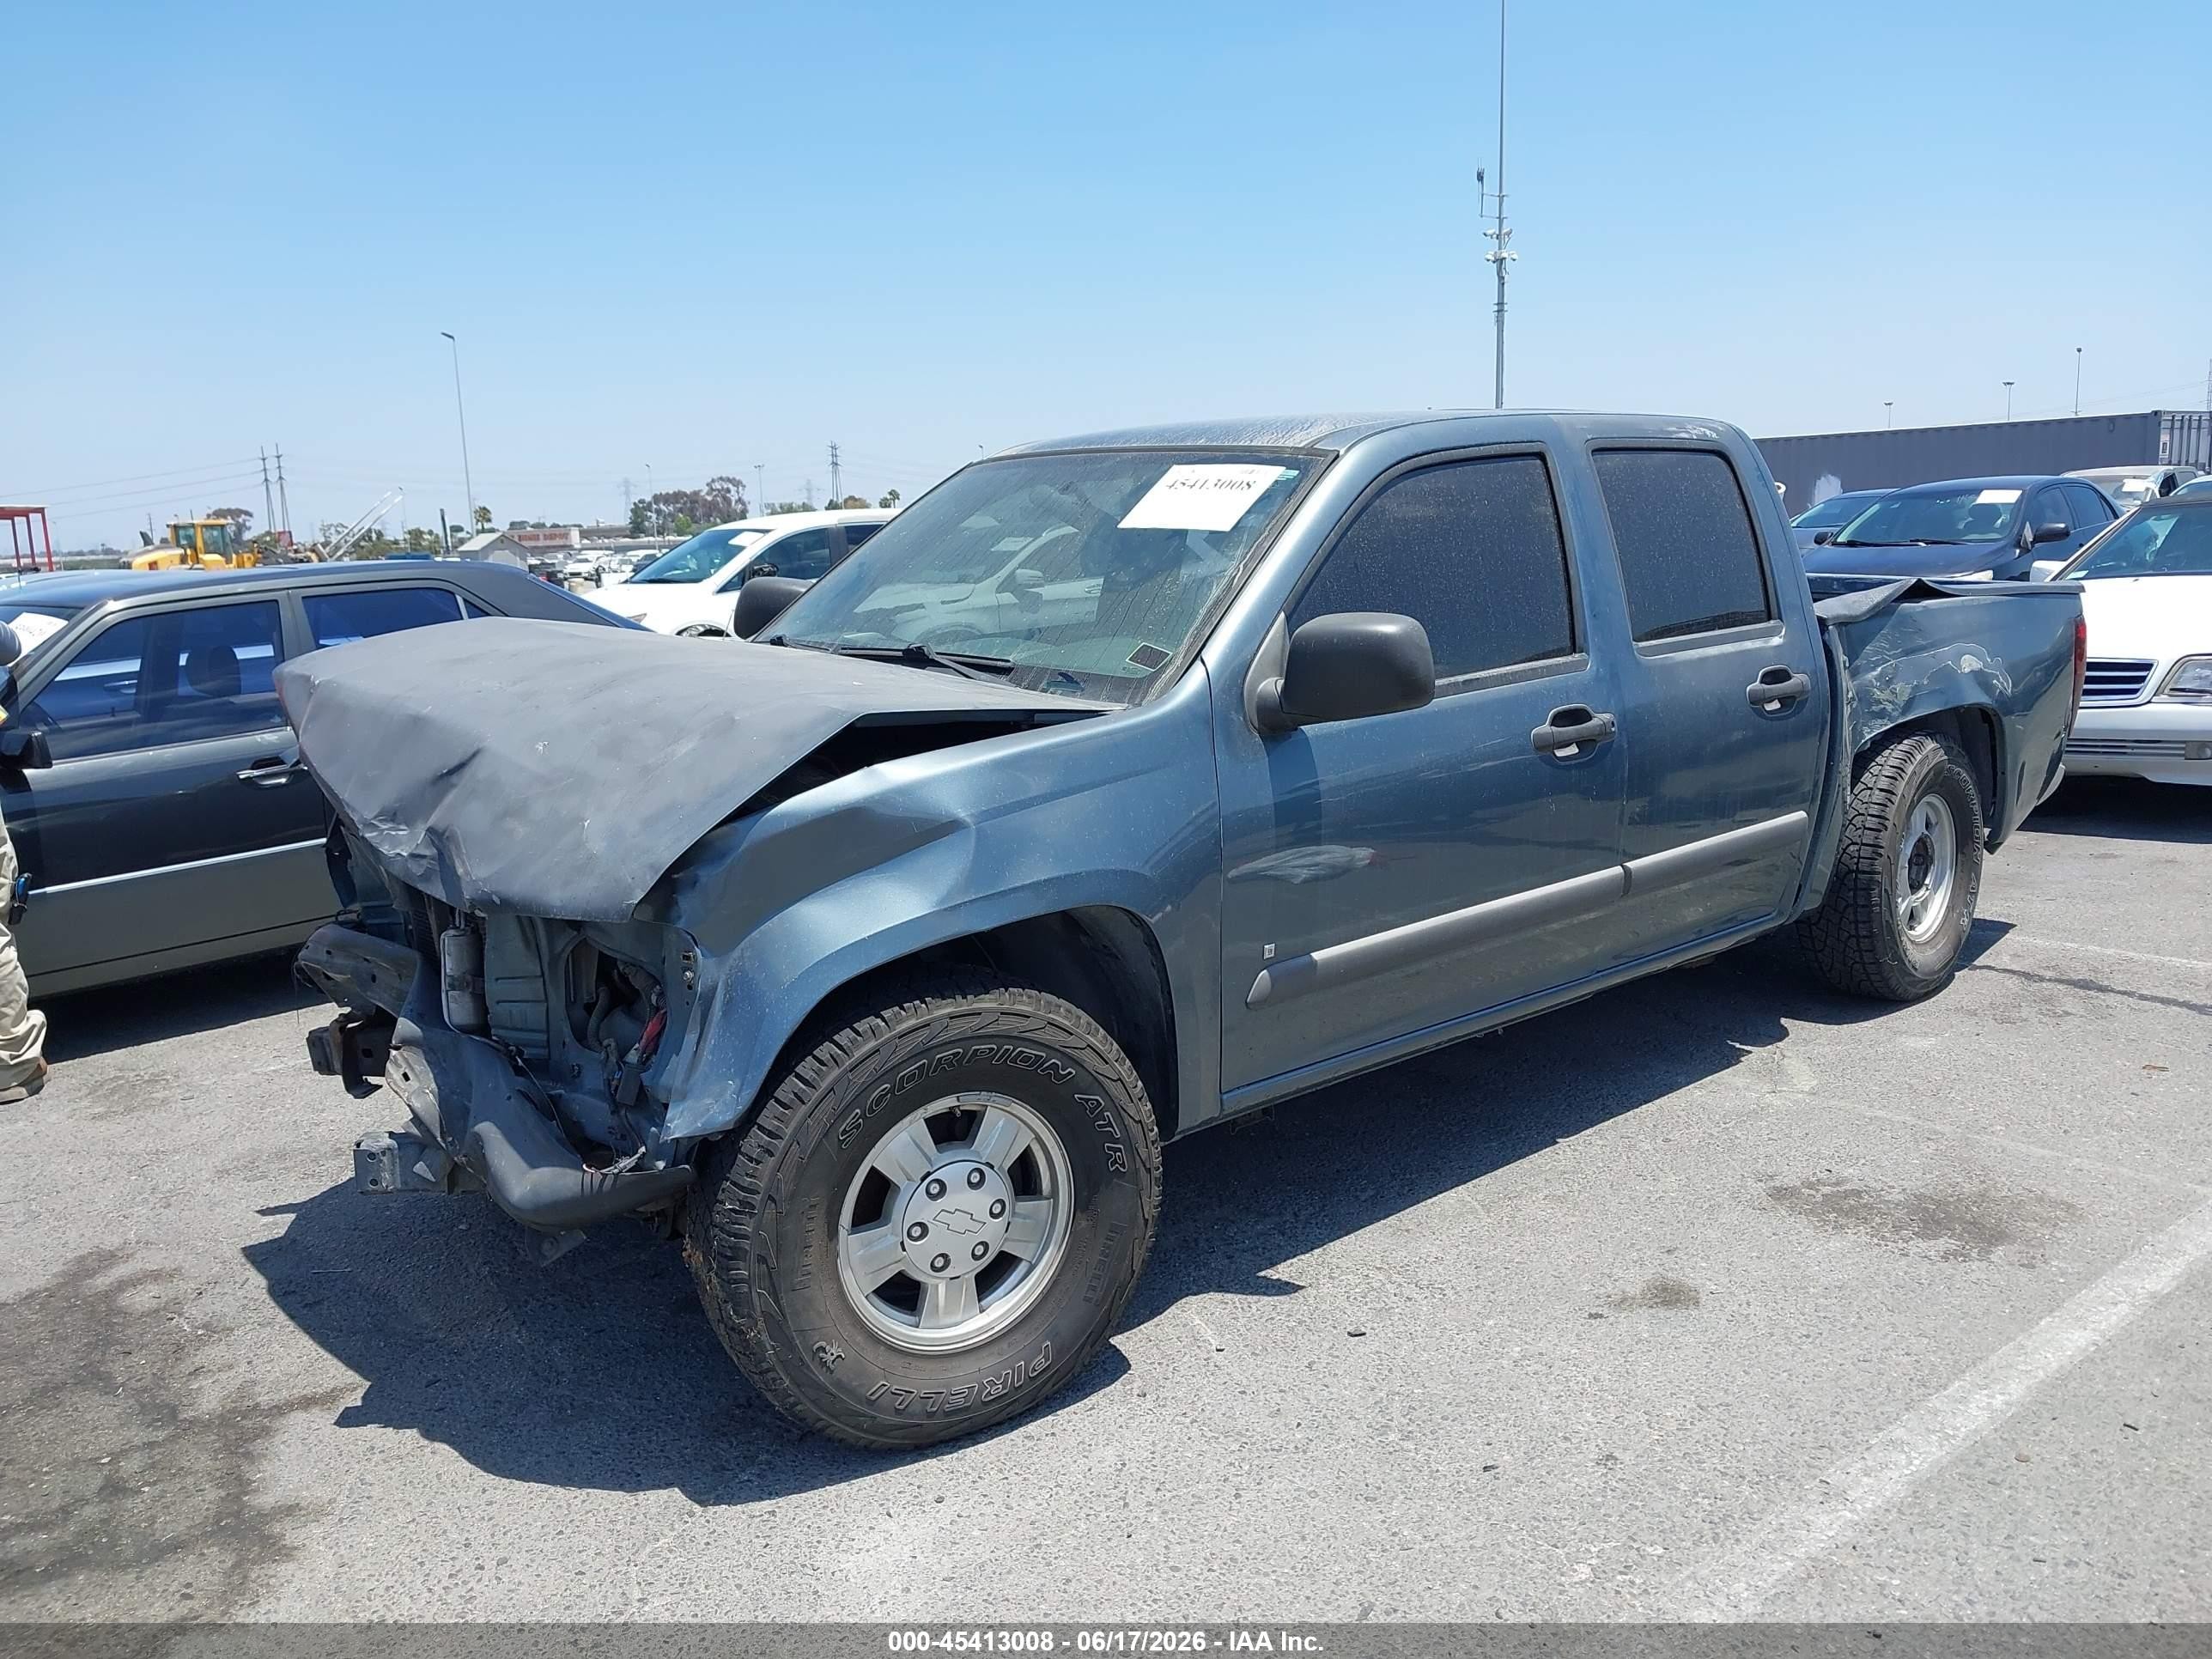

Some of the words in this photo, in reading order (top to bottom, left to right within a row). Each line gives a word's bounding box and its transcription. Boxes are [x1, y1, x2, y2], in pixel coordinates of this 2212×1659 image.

[838, 1044, 1076, 1149] SCORPION
[1074, 1093, 1128, 1173] ATR
[866, 1341, 1053, 1413] PIRELLI
